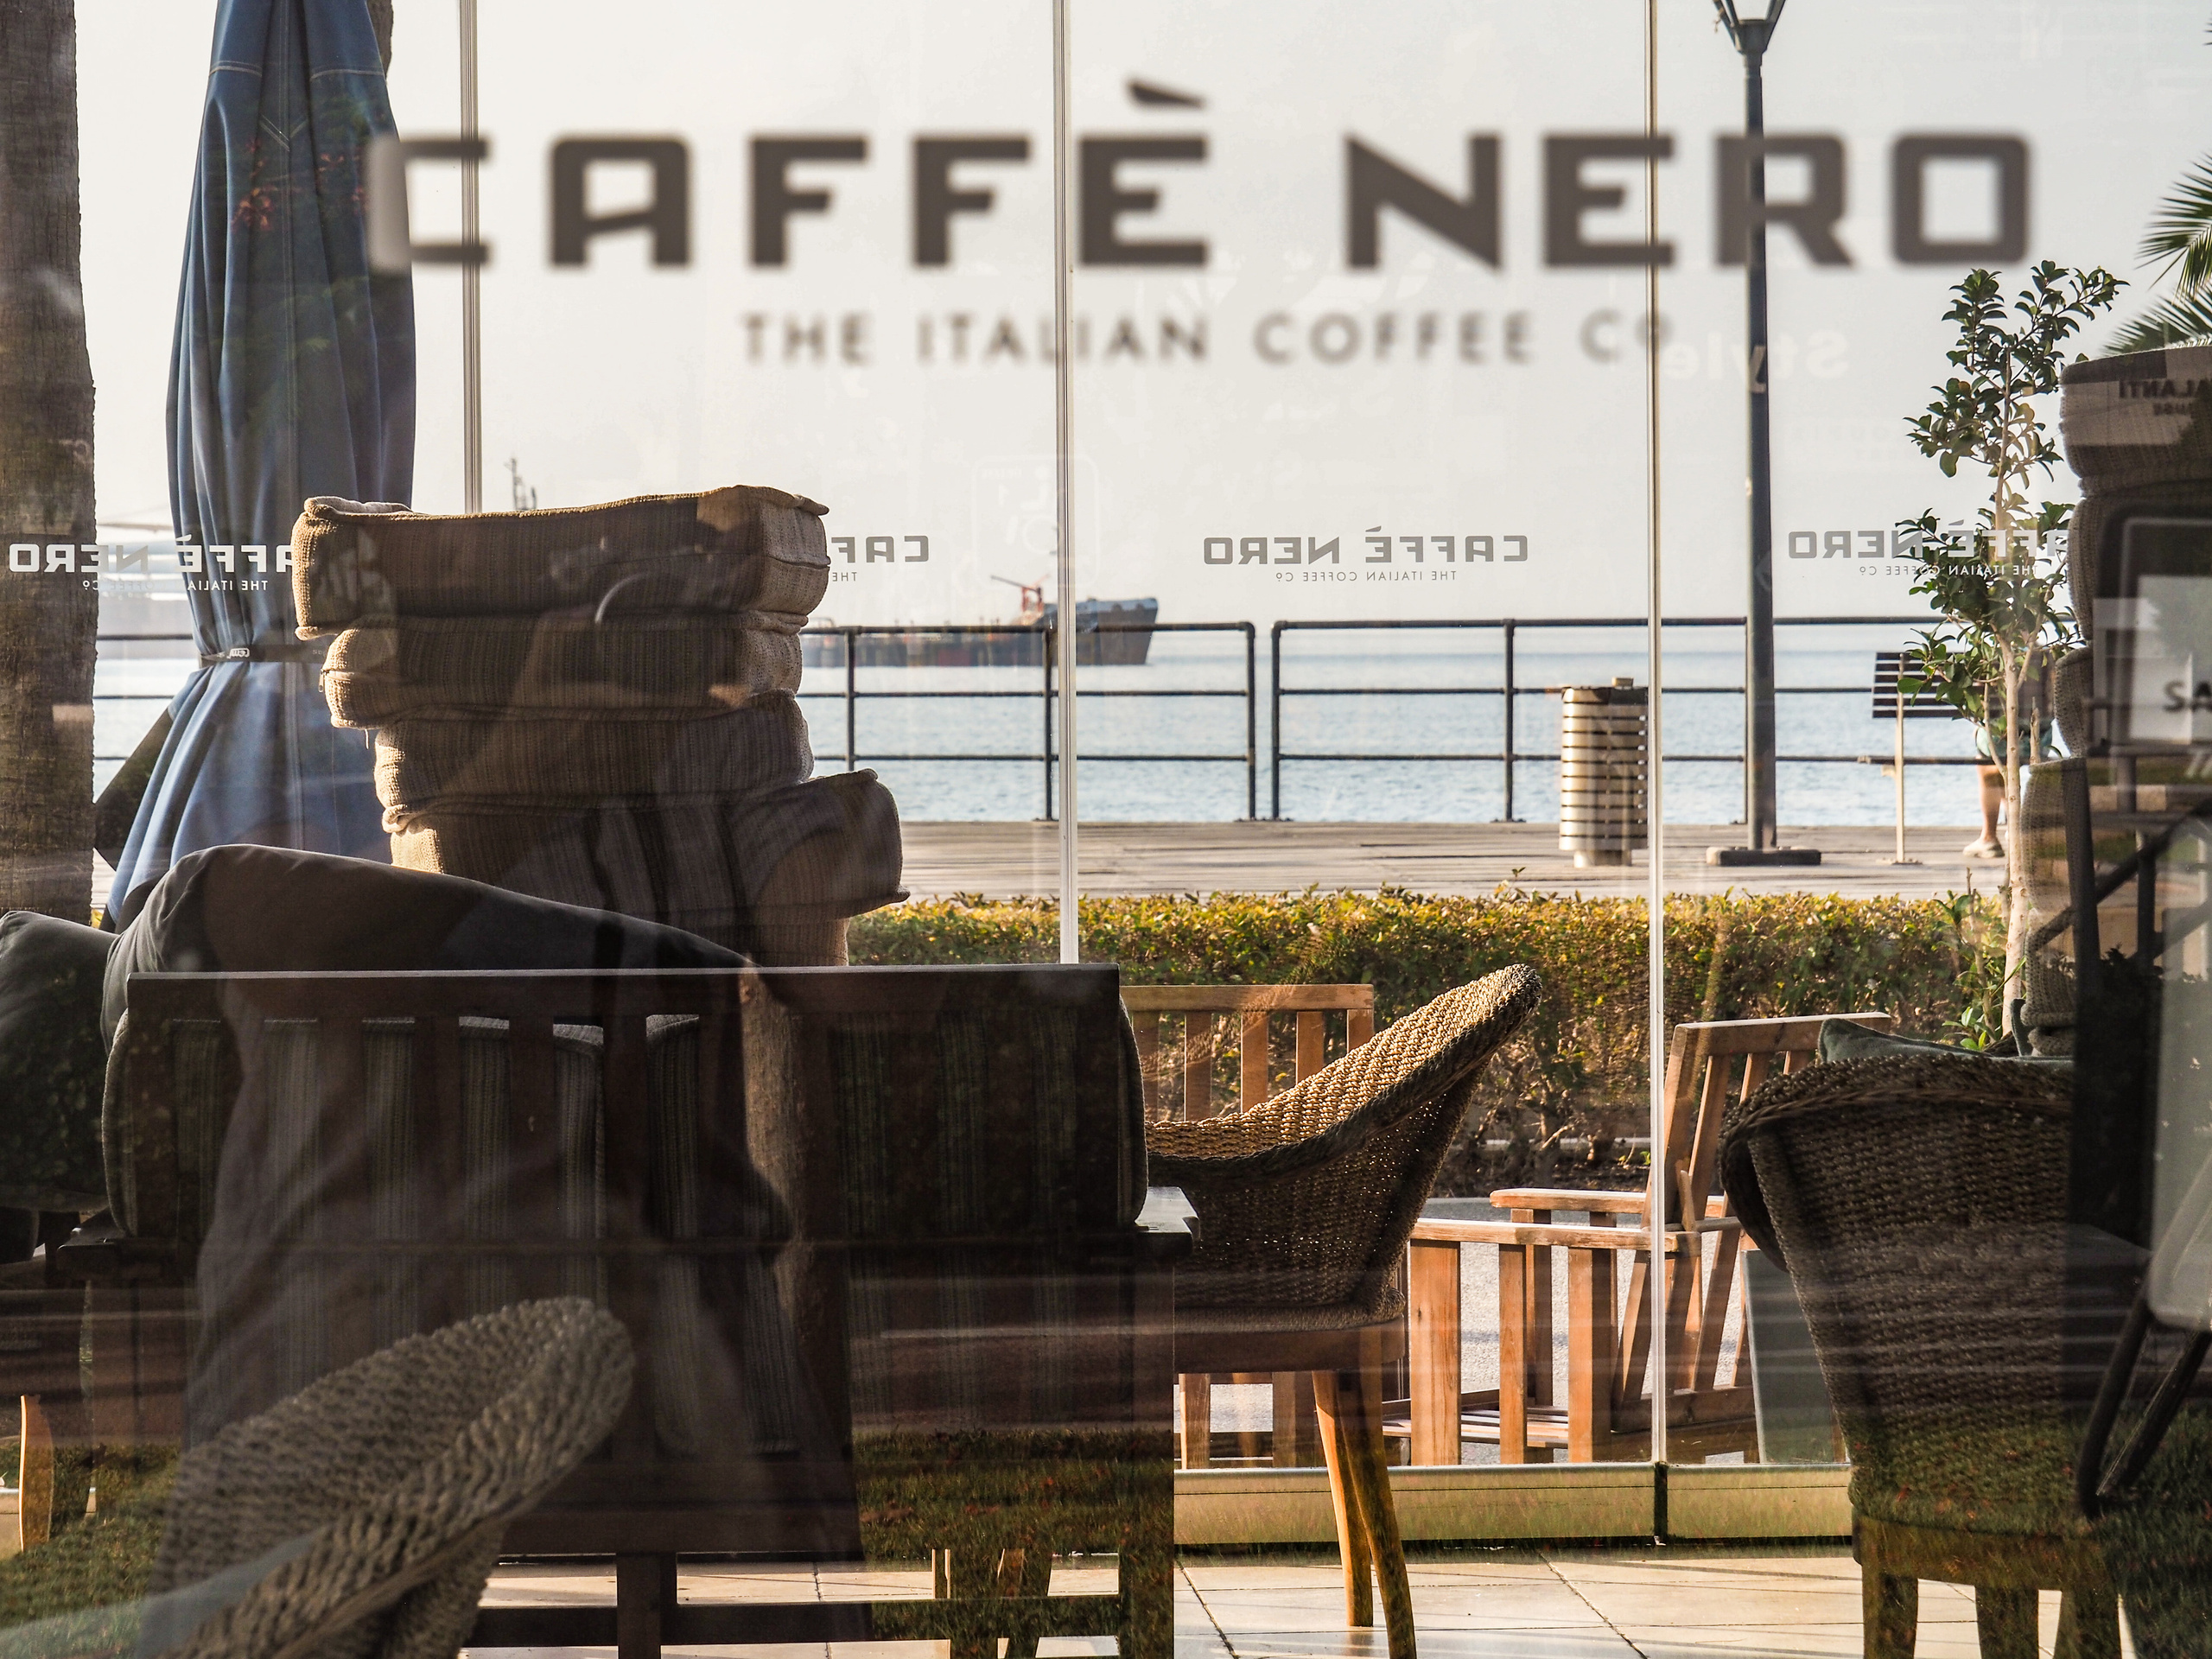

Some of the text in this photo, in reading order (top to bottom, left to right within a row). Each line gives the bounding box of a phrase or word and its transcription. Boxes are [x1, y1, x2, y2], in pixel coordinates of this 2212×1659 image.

[366, 78, 2033, 270] CAFFÈ NERO
[740, 310, 868, 365] THE
[916, 310, 1210, 365] ITALIAN
[1252, 309, 1535, 365] COFFEE
